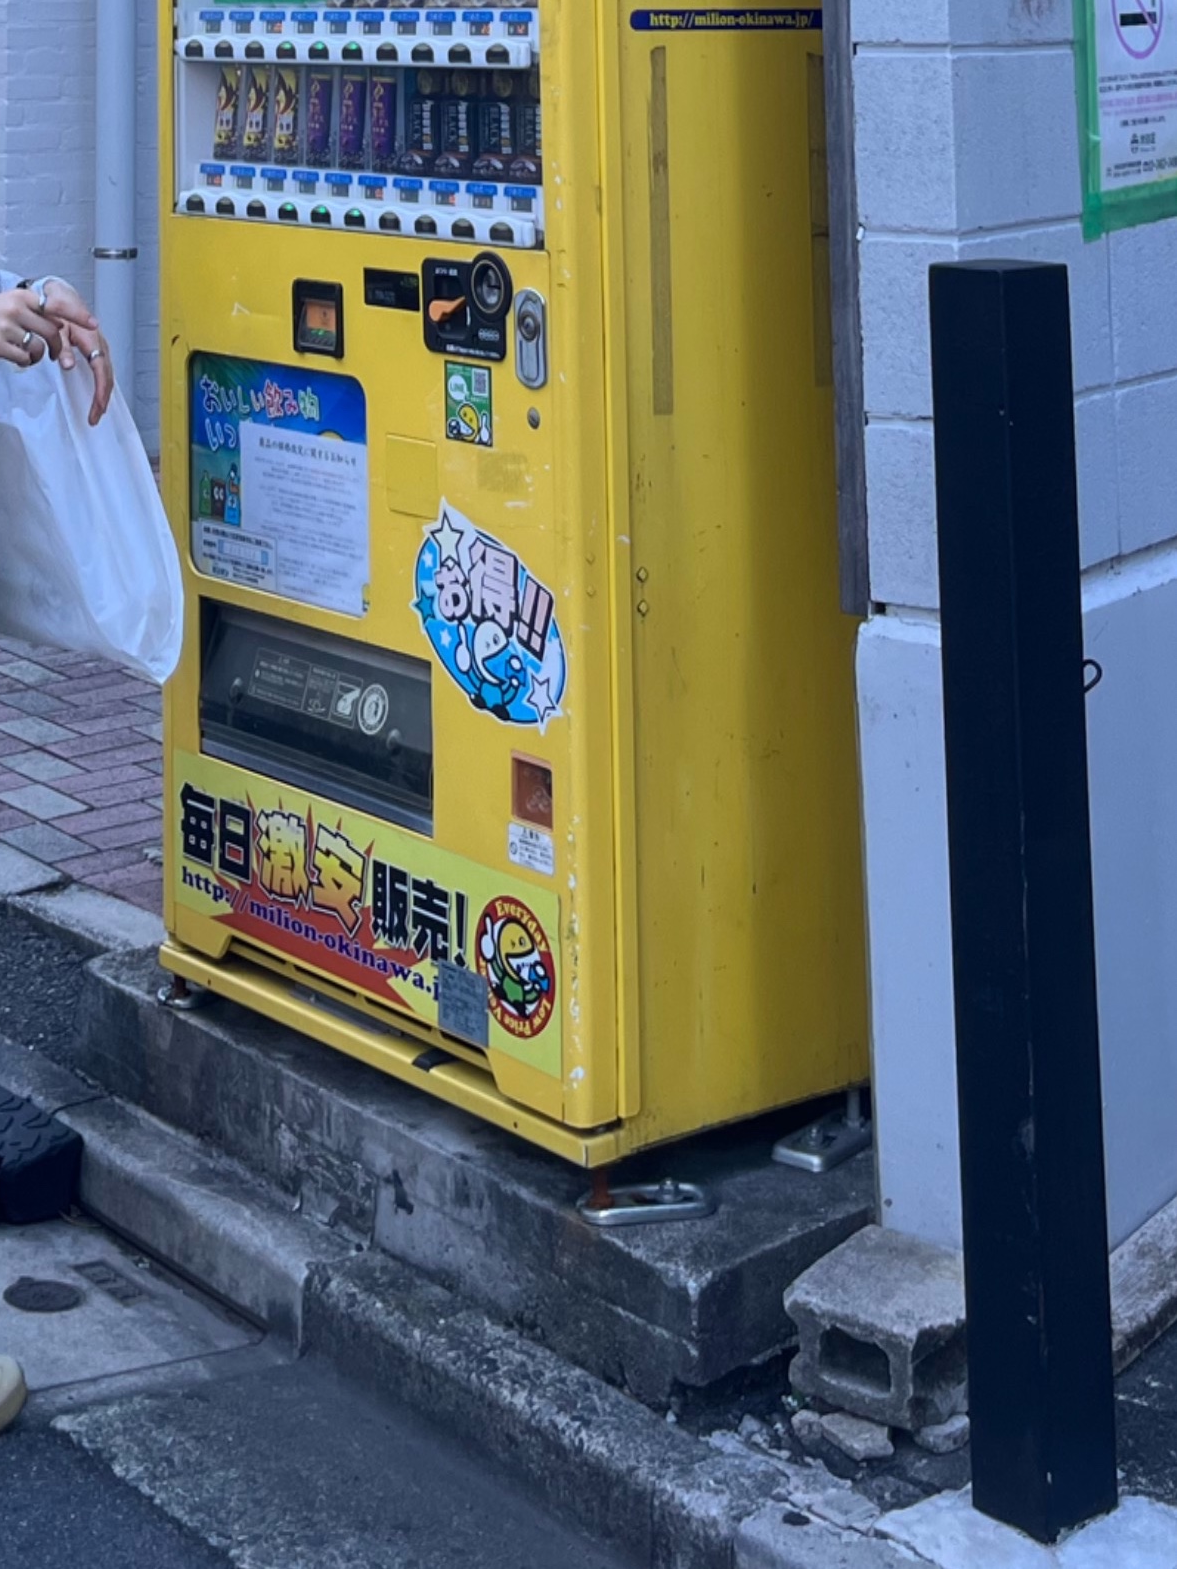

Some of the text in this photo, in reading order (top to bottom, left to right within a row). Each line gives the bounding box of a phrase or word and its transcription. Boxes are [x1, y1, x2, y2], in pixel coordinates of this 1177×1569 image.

[649, 11, 814, 29] http://milion-okinawa.jp/
[179, 781, 469, 970] 毎日激安販売!
[181, 866, 439, 1001] http://milion-okinawa.j
[494, 899, 549, 952] Everyday
